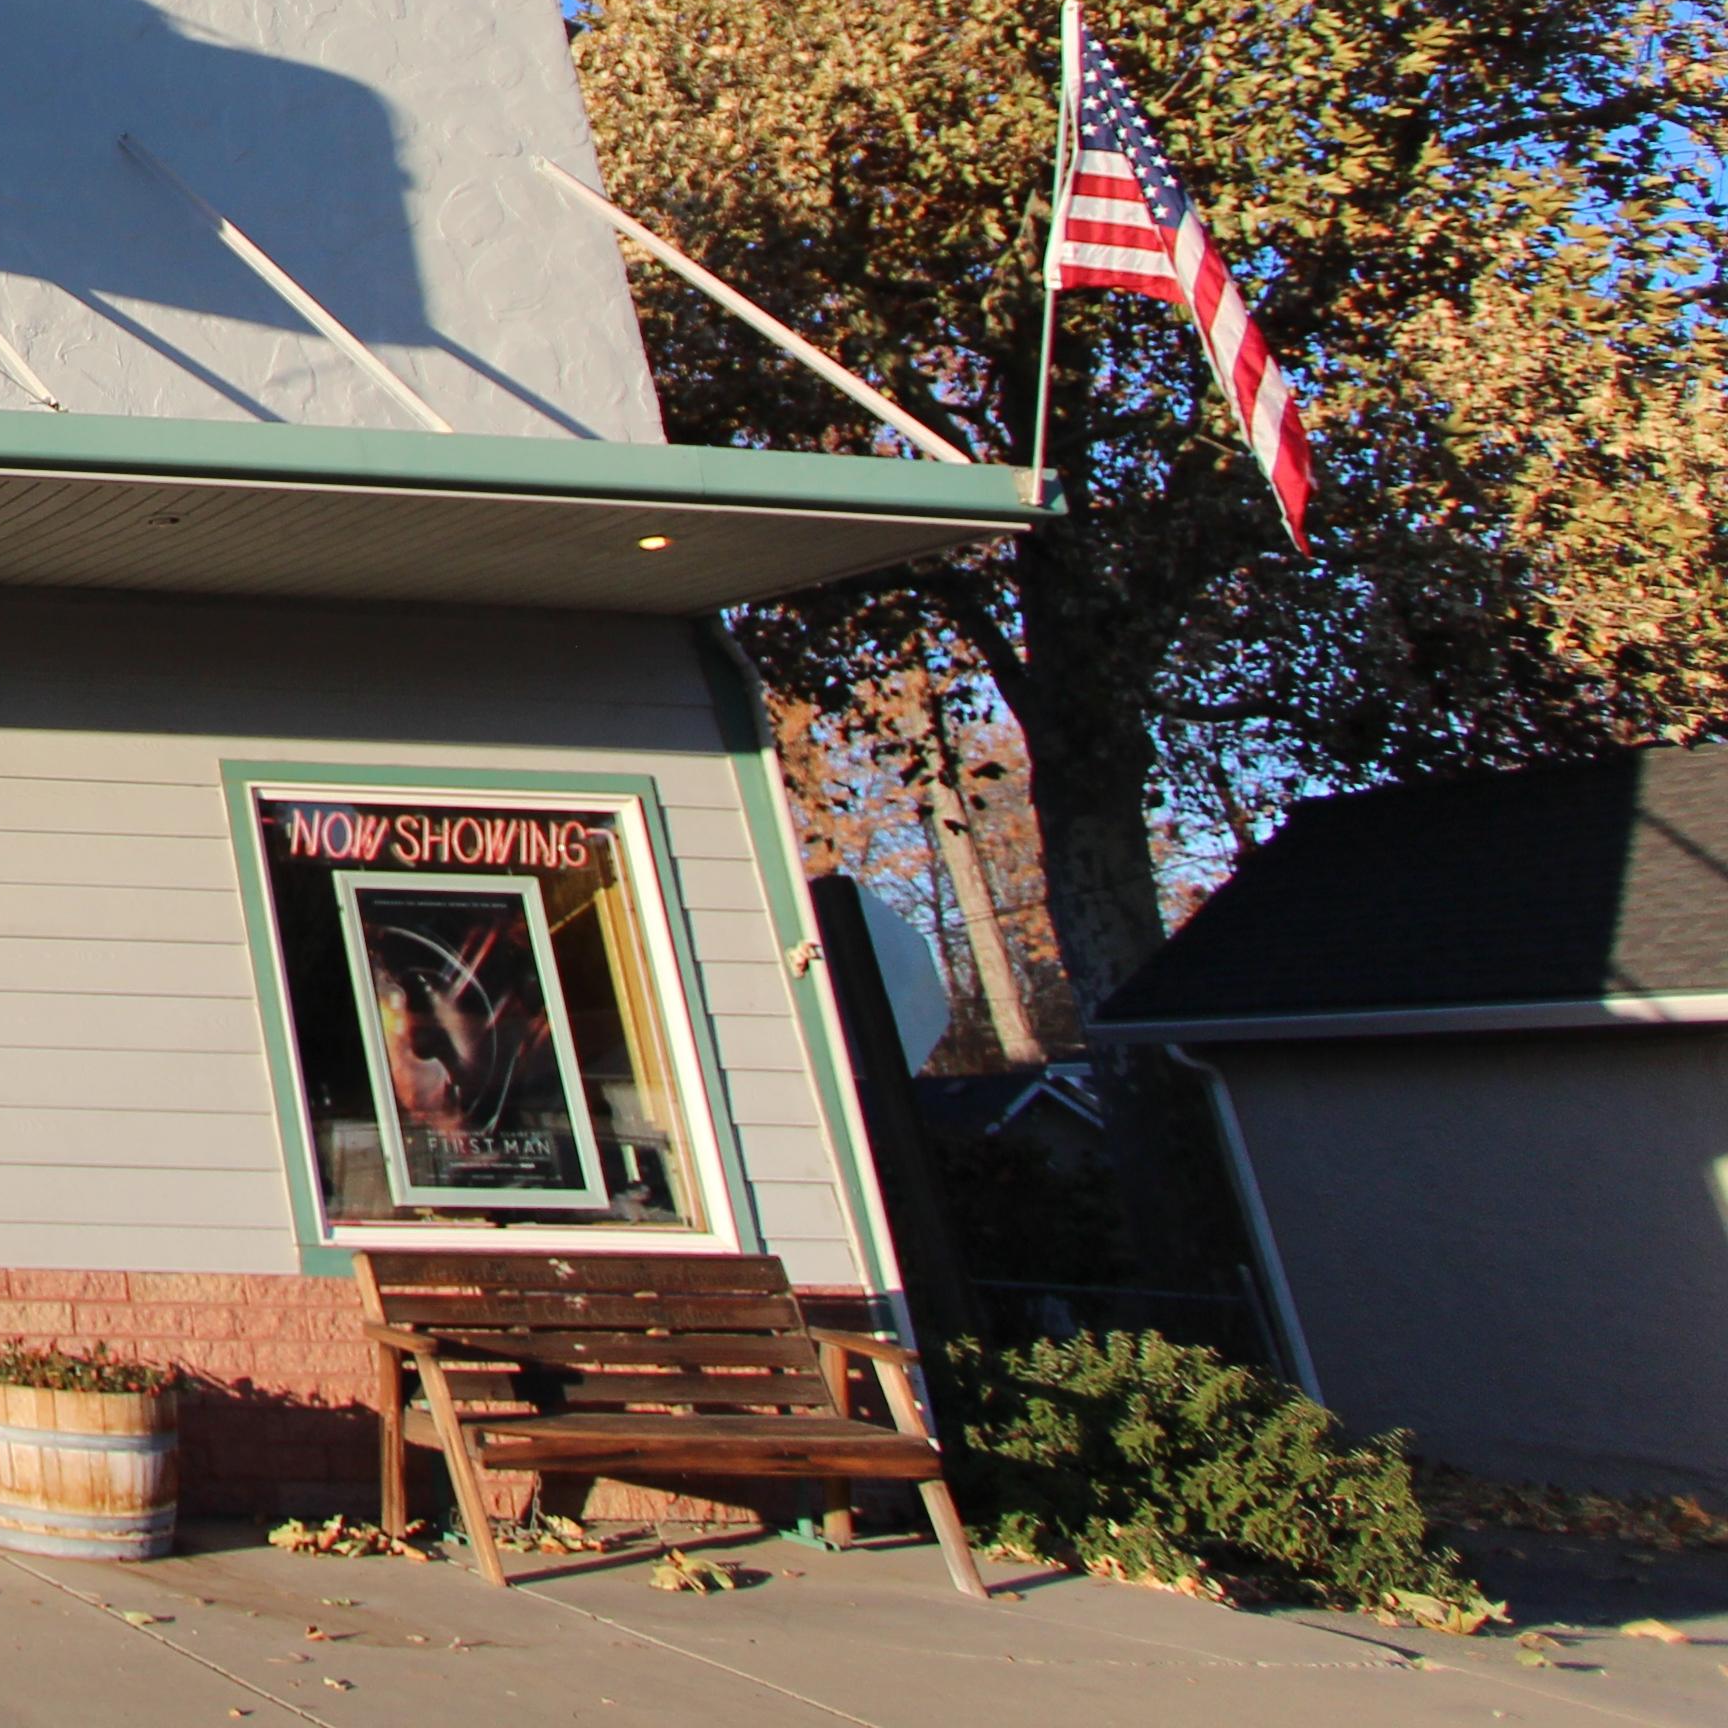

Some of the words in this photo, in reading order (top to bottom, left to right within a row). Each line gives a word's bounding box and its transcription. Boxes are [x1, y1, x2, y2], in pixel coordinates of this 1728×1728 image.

[290, 808, 389, 861] NOW
[392, 814, 590, 868] SHOWING
[428, 1138, 495, 1154] FIRST
[503, 1139, 551, 1155] MAN
